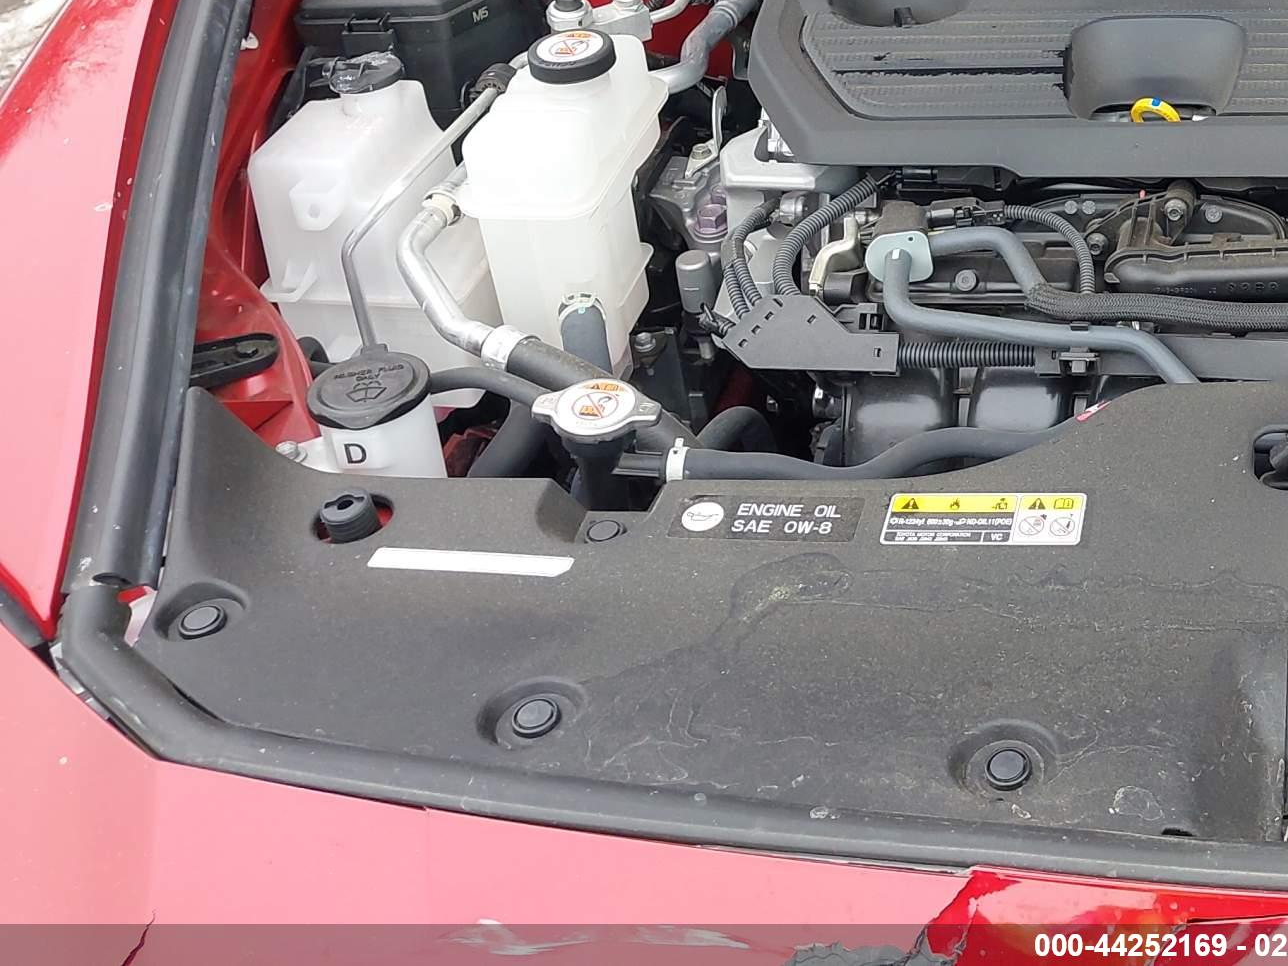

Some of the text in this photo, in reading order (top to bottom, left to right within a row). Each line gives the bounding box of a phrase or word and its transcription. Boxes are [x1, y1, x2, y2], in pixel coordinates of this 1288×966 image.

[471, 5, 489, 23] M5
[343, 442, 367, 464] D
[736, 503, 841, 519] ENGINE OIL
[731, 519, 833, 535] SAE 0W-8
[990, 533, 1003, 542] VC
